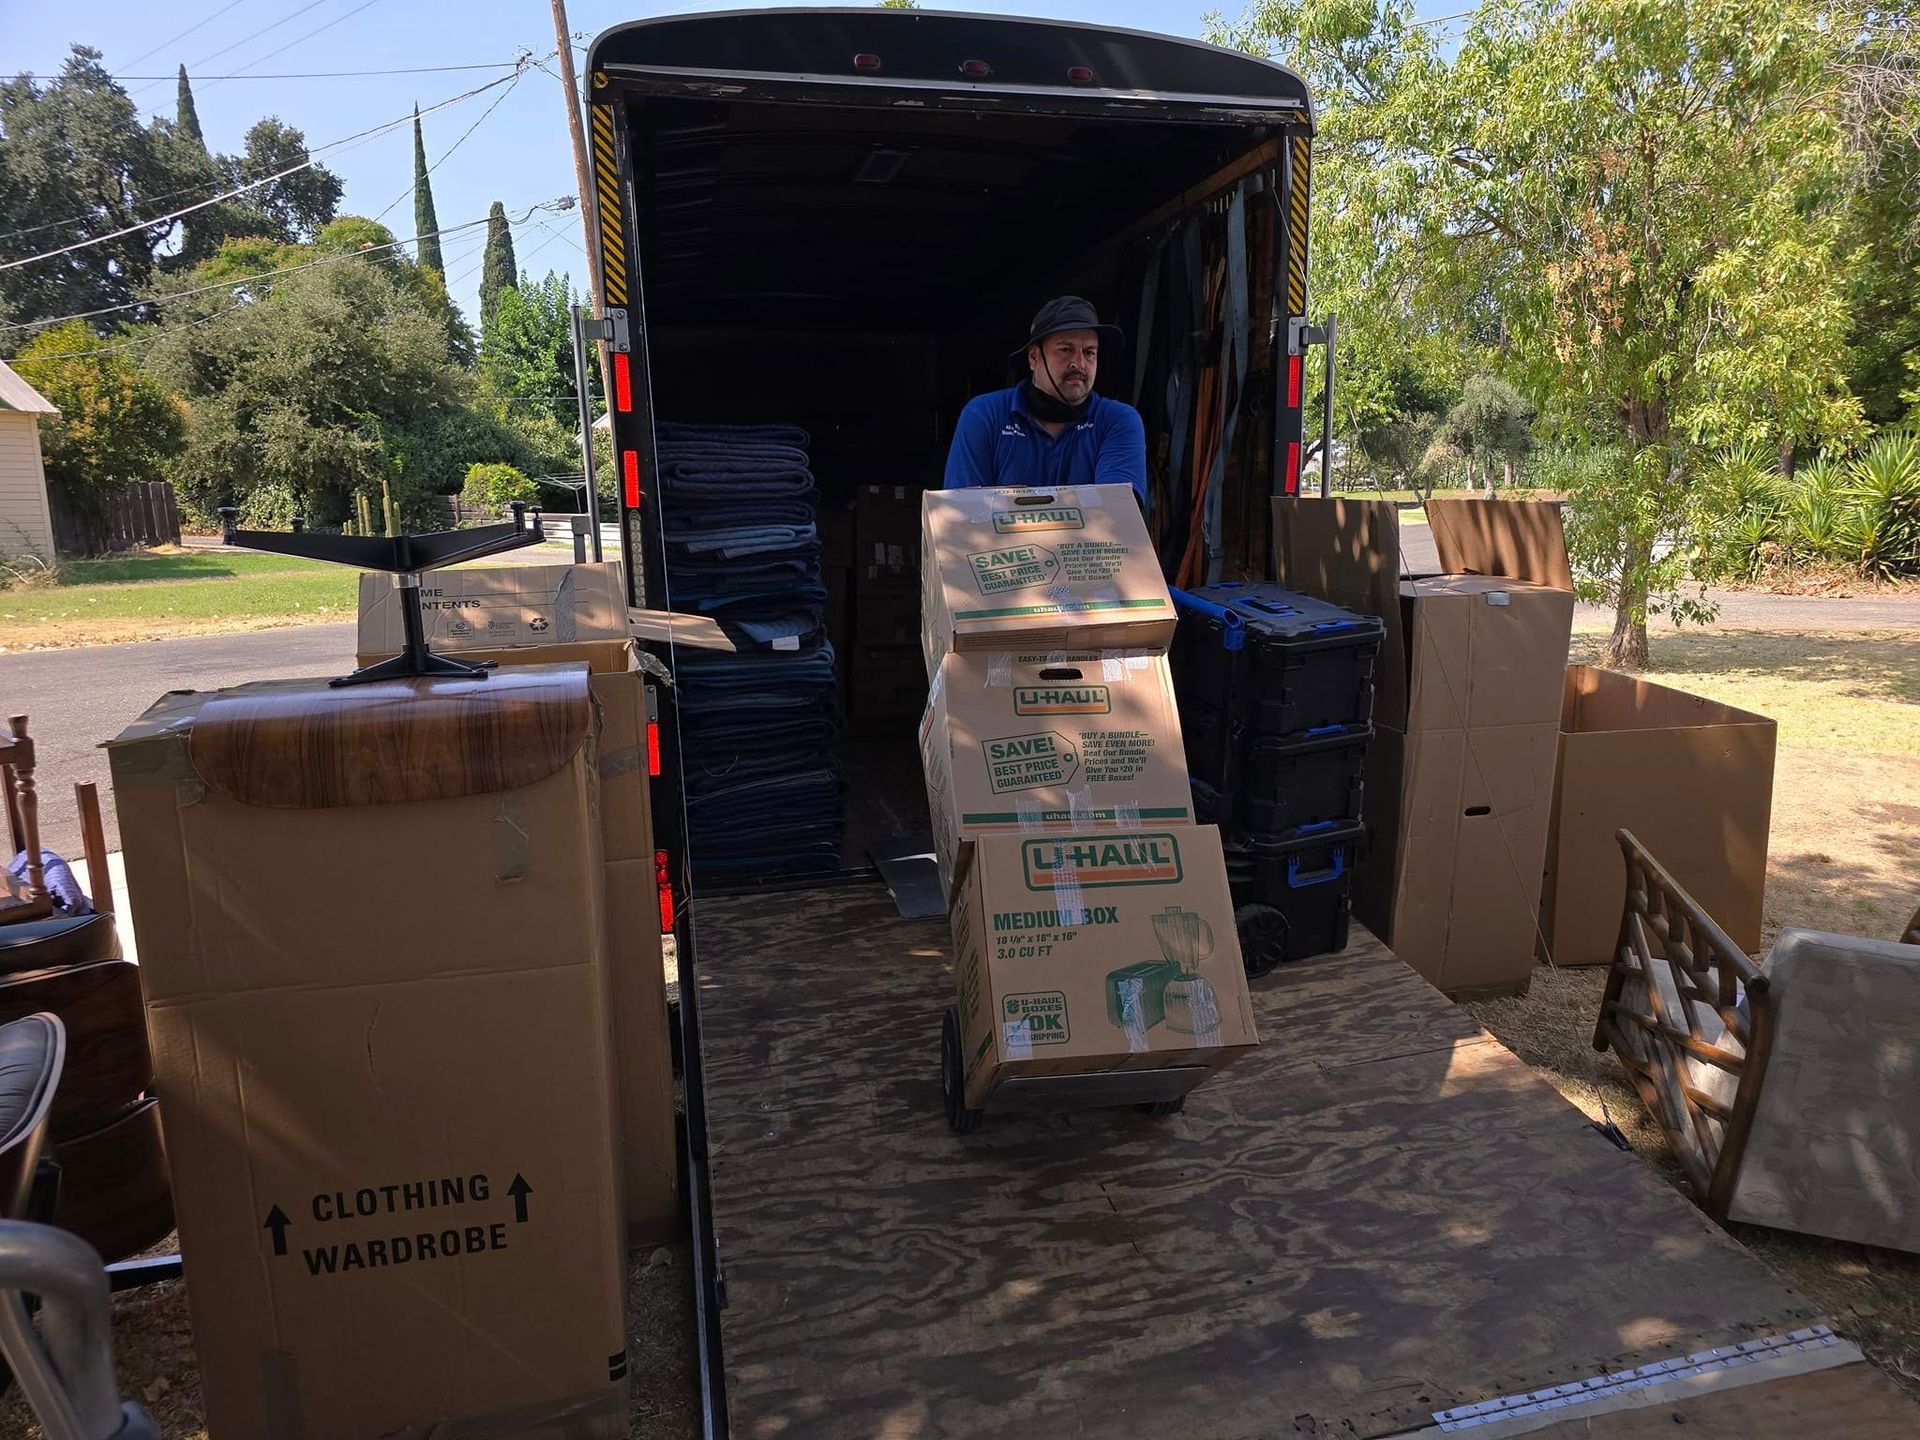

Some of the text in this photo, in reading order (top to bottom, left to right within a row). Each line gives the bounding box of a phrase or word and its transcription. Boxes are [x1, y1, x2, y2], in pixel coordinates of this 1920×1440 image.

[976, 548, 1037, 568] SAVE!
[981, 565, 1041, 582] BEST PRICE
[422, 600, 481, 610] NTENTS
[990, 736, 1055, 759] SAVE!
[1129, 739, 1155, 747] MORE!
[1119, 748, 1146, 756] Bundle
[994, 759, 1059, 777] BEST PRICE
[1105, 765, 1119, 773] You
[1109, 773, 1134, 781] Boxes!
[993, 906, 1119, 931] MEDIUM BOX
[997, 935, 1008, 945] 18
[1027, 935, 1034, 943] x
[1053, 933, 1060, 941] x
[997, 945, 1053, 959] 3.0 CU FT
[1023, 1004, 1063, 1013] BOXES
[1029, 1014, 1064, 1031] OK
[1031, 1032, 1065, 1041] SHIPPING
[312, 1174, 490, 1222] CLOTHING
[302, 1224, 508, 1275] WARDROBE
